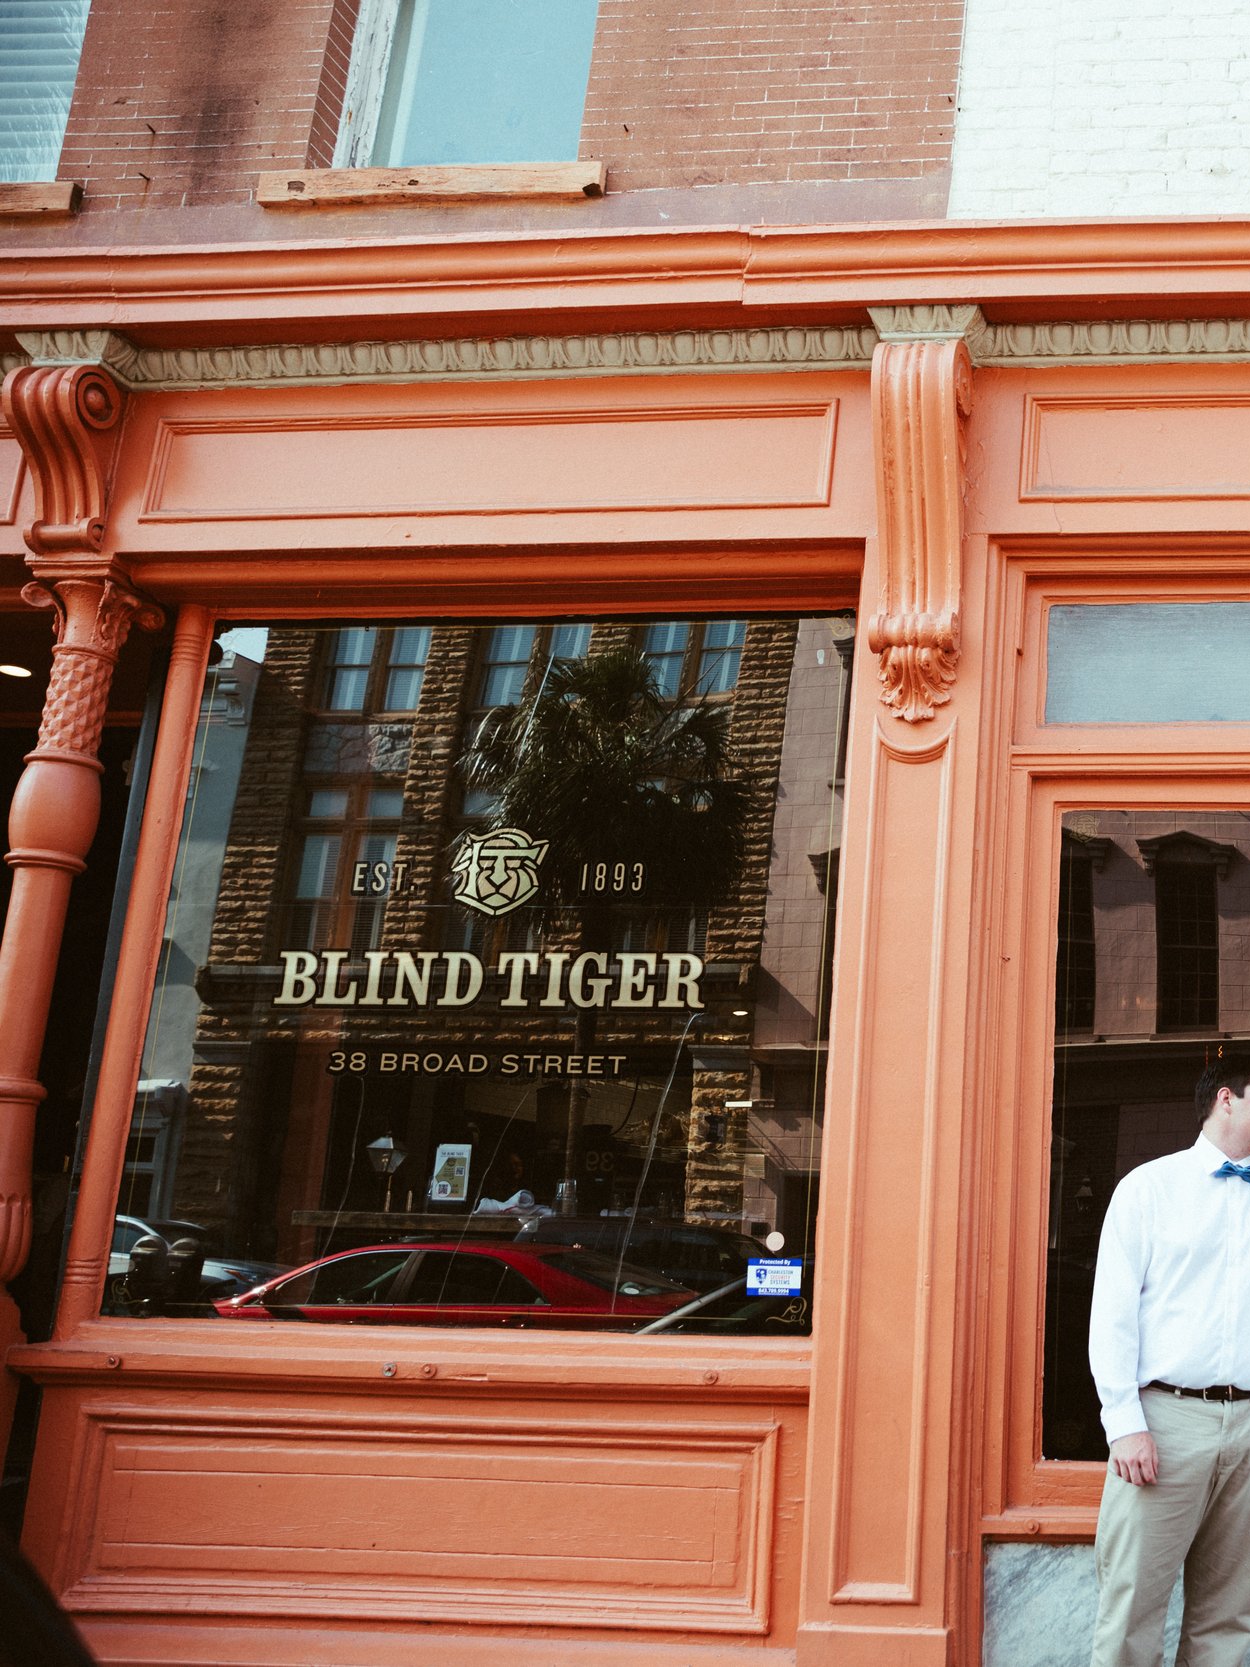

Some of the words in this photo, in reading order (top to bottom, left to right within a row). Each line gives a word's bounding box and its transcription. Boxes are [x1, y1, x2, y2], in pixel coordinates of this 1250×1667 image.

[352, 862, 417, 893] EST.
[580, 862, 646, 892] 1893
[273, 950, 485, 1006] BLIND
[497, 951, 705, 1009] TIGER
[328, 1051, 367, 1072] 38
[379, 1052, 490, 1074] BROAD
[500, 1053, 627, 1075] STREET
